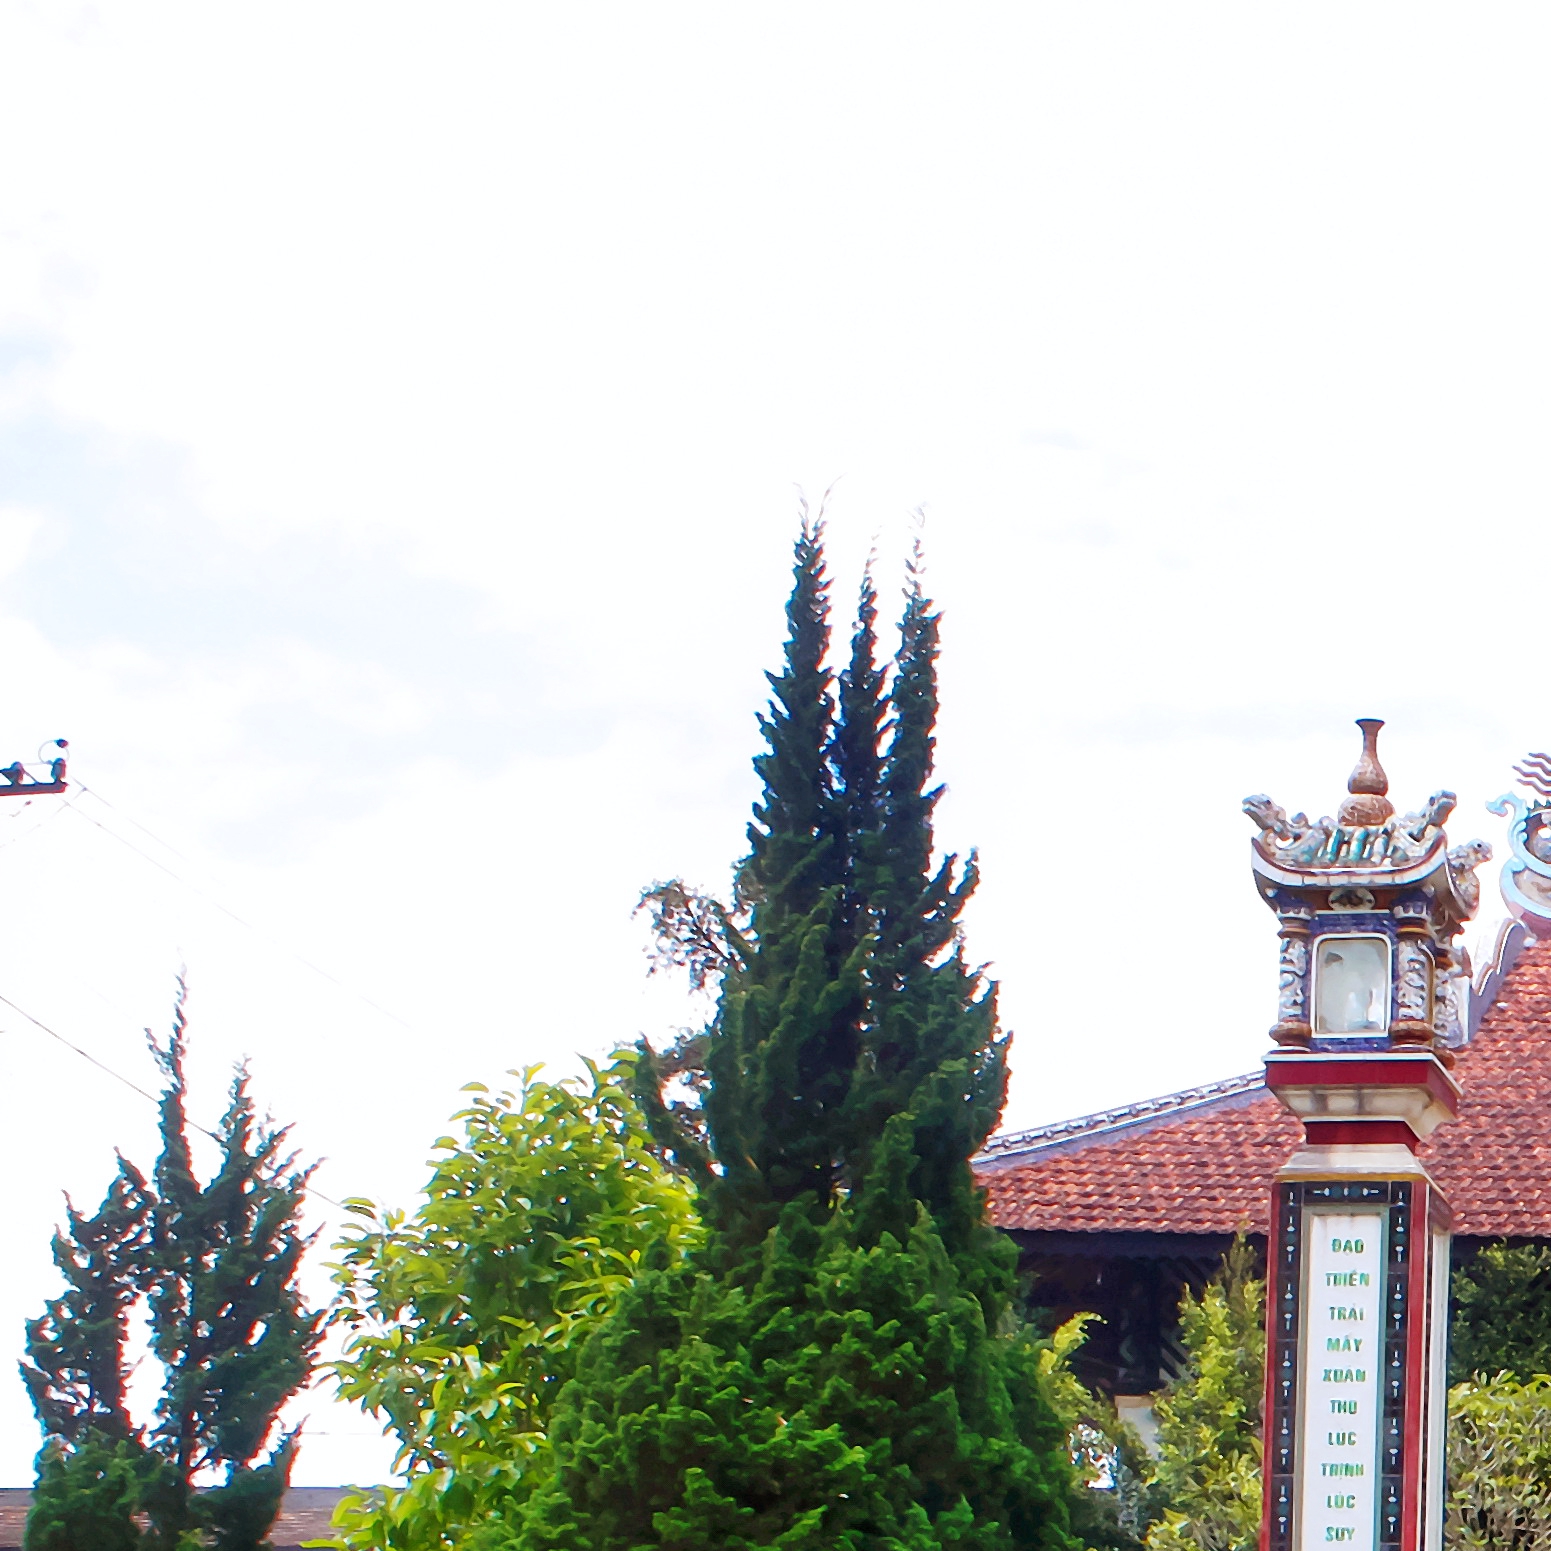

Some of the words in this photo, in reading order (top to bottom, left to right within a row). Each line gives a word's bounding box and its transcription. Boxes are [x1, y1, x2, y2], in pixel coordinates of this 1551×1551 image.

[1330, 1399, 1358, 1415] THU
[1326, 1491, 1356, 1509] LÚC
[1325, 1526, 1355, 1542] SUY
